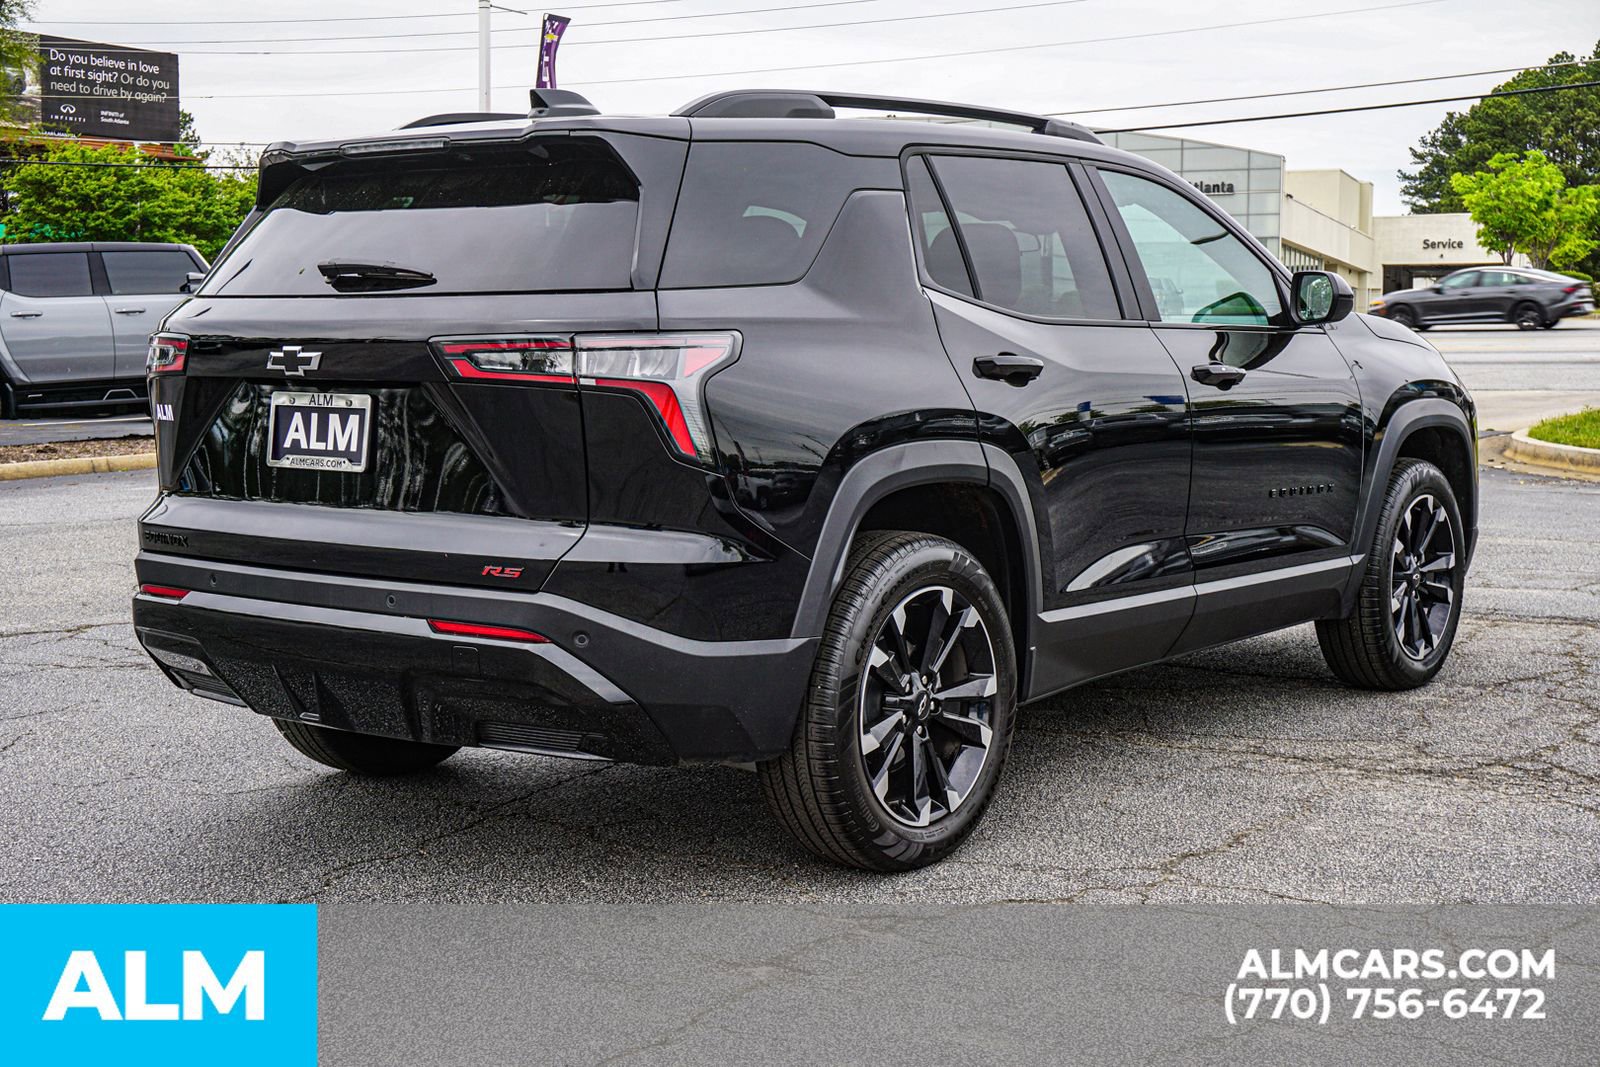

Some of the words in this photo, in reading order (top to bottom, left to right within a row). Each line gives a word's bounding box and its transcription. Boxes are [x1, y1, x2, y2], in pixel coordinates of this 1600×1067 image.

[50, 49, 65, 61] Do
[68, 53, 88, 65] you
[90, 54, 126, 69] believe
[127, 59, 137, 71] in
[139, 61, 160, 74] love
[50, 66, 61, 76] at
[63, 66, 86, 79] first
[87, 70, 118, 83] sight?
[120, 73, 135, 85] Or
[136, 76, 149, 87] do
[152, 80, 170, 91] you
[50, 81, 77, 93] need
[79, 84, 90, 94] to
[93, 85, 118, 97] drive
[120, 88, 132, 101] by
[134, 92, 167, 104] again?
[50, 114, 86, 123] INFINITI
[1422, 238, 1464, 250] Service
[309, 394, 334, 406] ALM
[283, 411, 360, 452] ALM
[290, 457, 343, 468] ALMCARS.COM
[481, 565, 525, 578] RS
